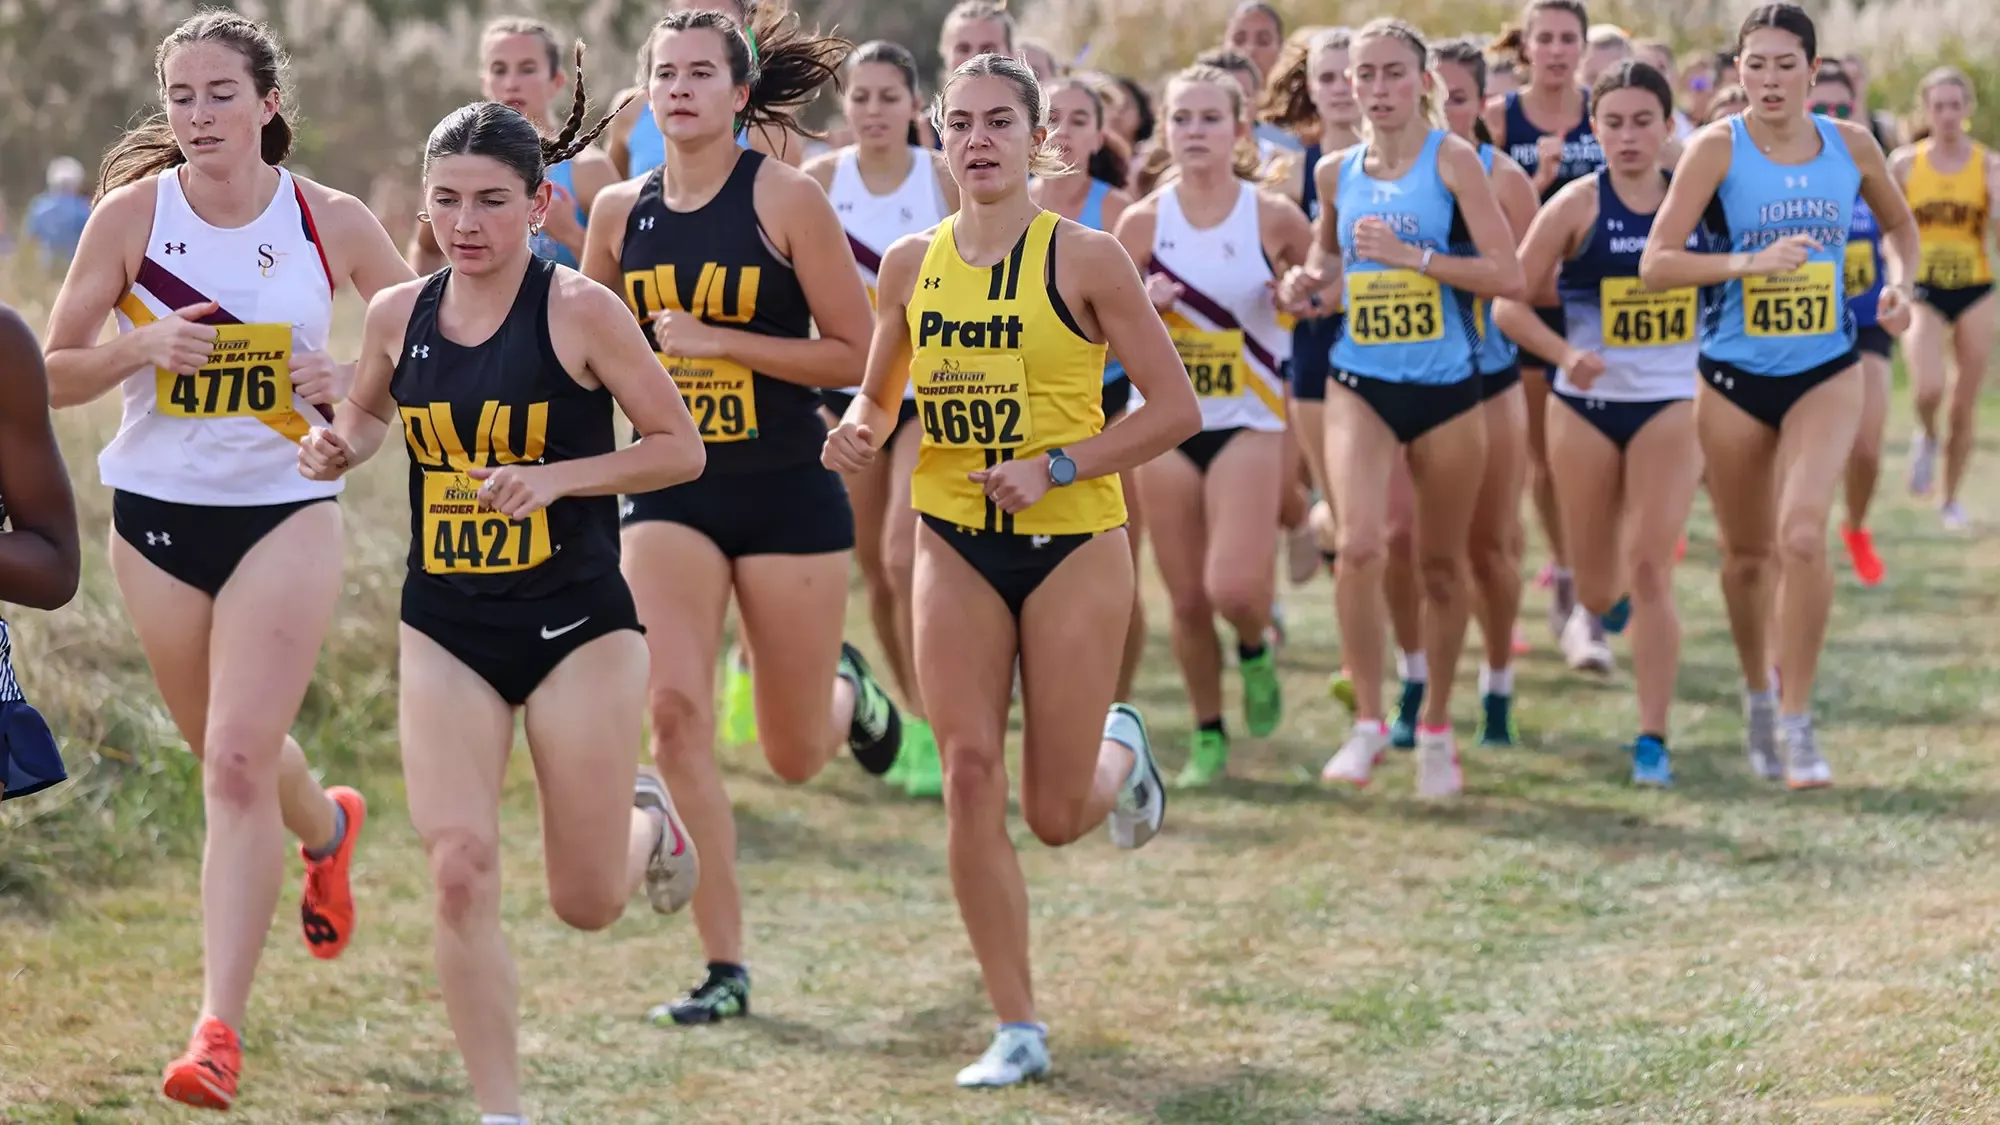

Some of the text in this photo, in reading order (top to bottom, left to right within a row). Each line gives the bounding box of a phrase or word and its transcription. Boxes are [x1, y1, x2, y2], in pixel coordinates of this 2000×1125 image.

[1760, 199, 1840, 228] JOHNS
[919, 311, 1024, 349] Pratt
[1355, 303, 1434, 338] 4533
[1613, 308, 1686, 342] 4614
[1752, 296, 1829, 332] 4537
[225, 351, 285, 363] BATTLE
[170, 365, 276, 414] 4776
[695, 380, 744, 390] BATTLE
[917, 383, 1020, 396] BORDER BATTLE
[931, 371, 985, 383] Rowan
[923, 398, 1024, 445] 4692
[429, 503, 474, 514] BORDER
[433, 517, 532, 568] 4427
